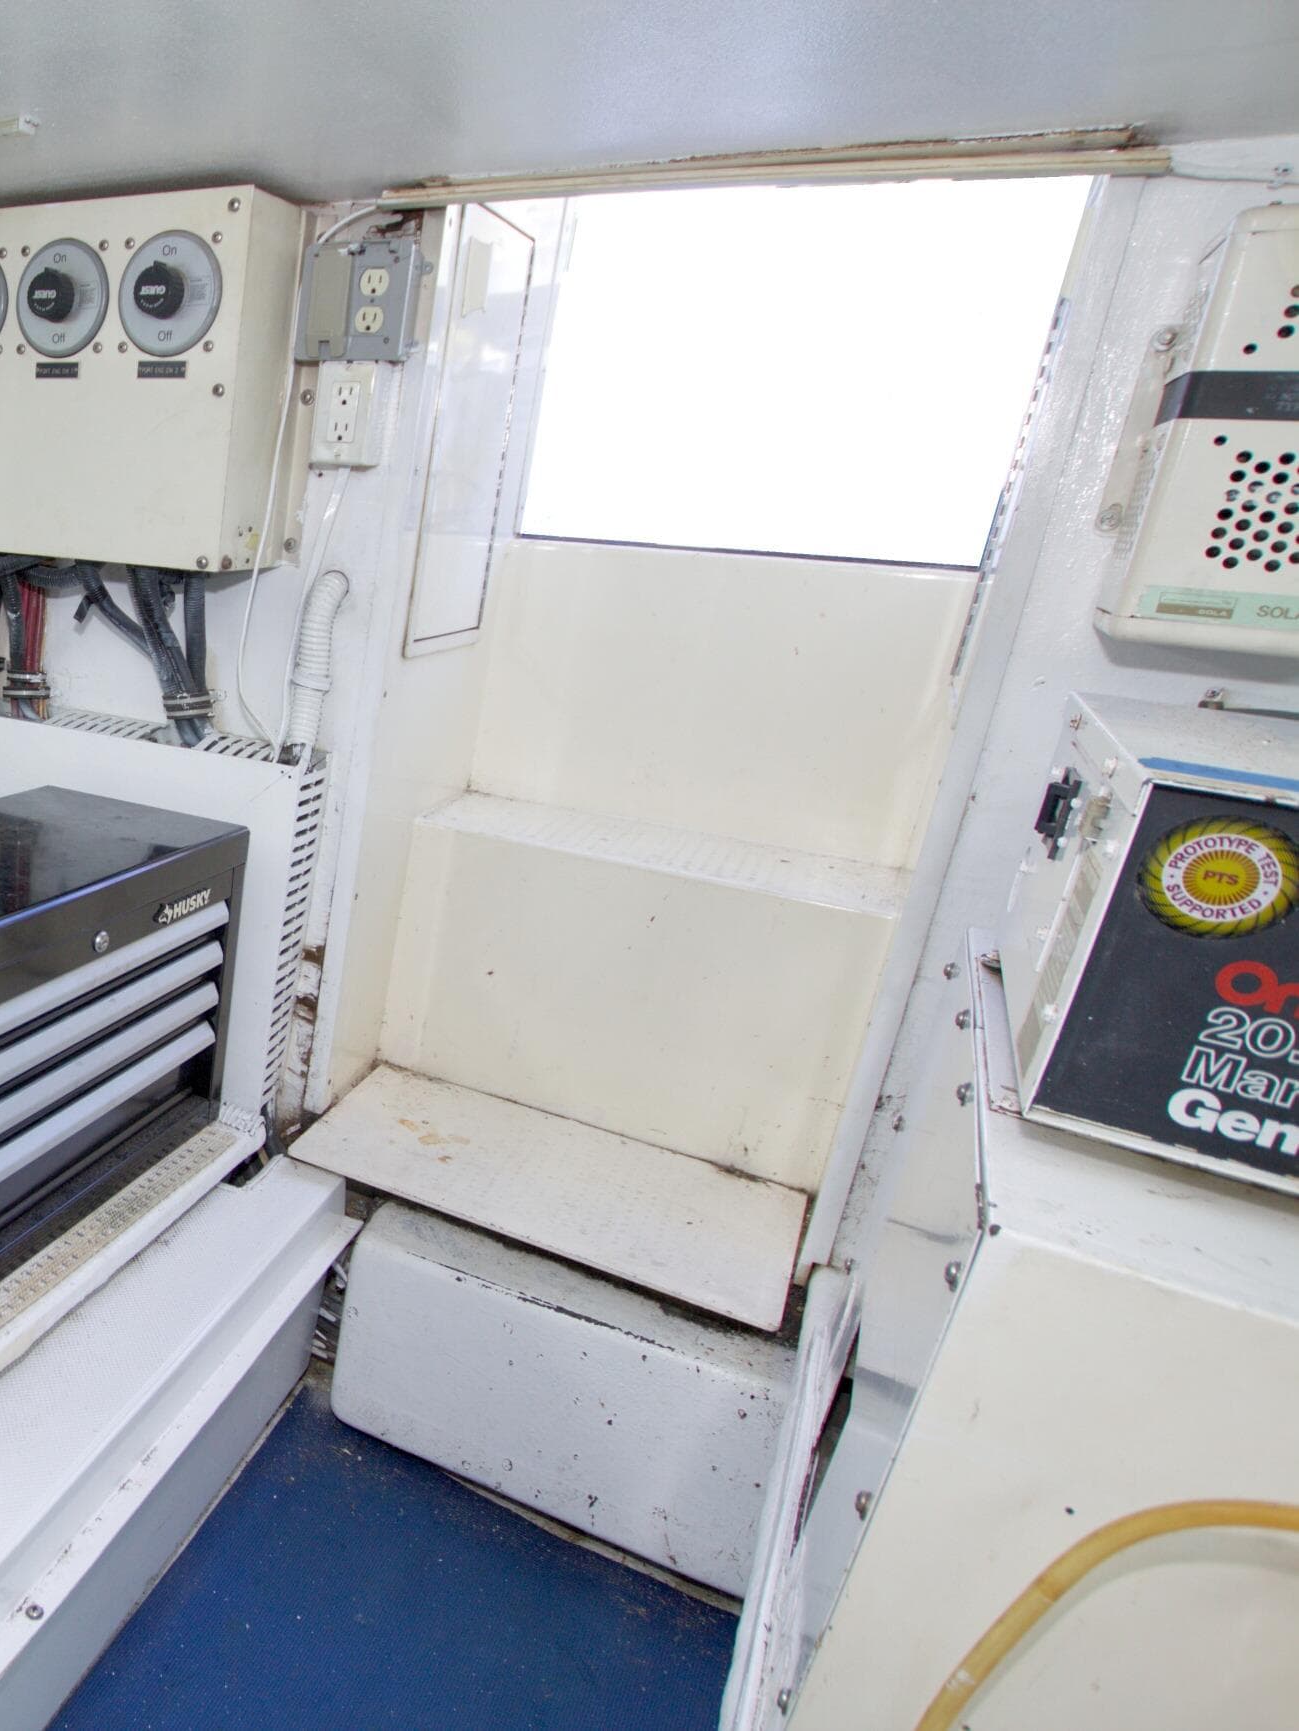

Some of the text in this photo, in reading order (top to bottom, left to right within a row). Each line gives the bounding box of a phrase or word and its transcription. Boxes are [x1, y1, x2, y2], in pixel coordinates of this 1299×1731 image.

[162, 245, 177, 256] On
[53, 252, 67, 264] On
[51, 332, 65, 344] Off
[157, 330, 172, 342] Off
[1168, 836, 1280, 887] PROTOTYPE TEST
[1203, 870, 1239, 886] PTS
[173, 888, 211, 920] HUSKY
[1166, 884, 1261, 919] SUPPORTED
